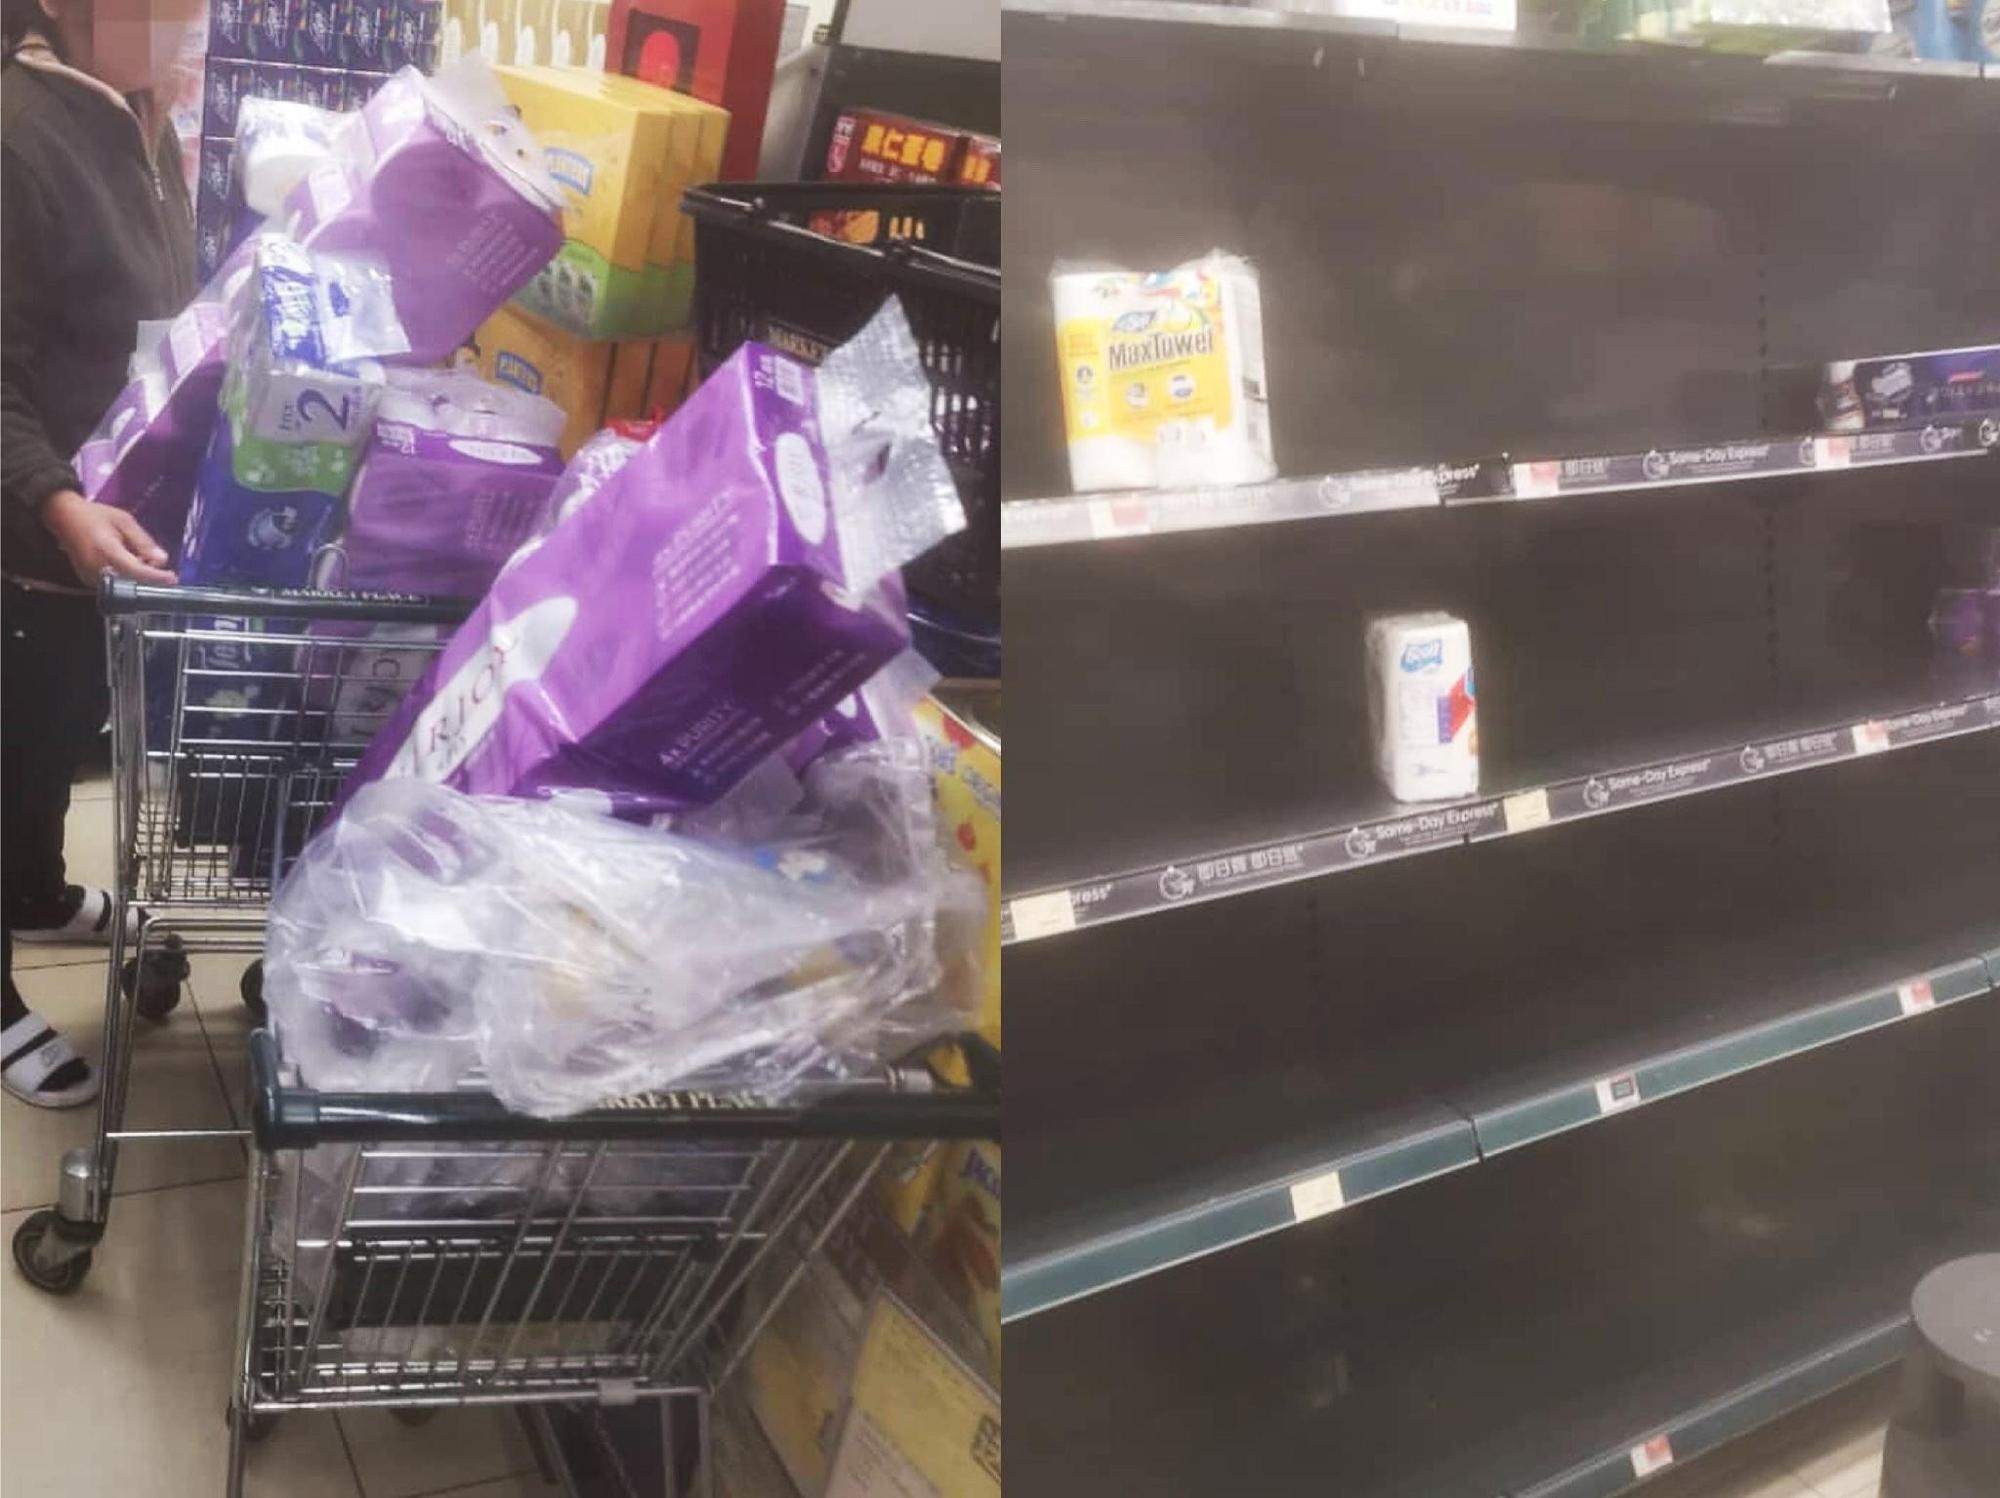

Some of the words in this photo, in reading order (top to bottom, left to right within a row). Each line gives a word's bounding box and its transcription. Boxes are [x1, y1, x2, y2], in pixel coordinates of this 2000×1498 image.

[297, 389, 350, 431] 2
[1608, 768, 1667, 791] Same-Day
[1668, 761, 1708, 779] Express
[1376, 814, 1446, 840] Same-Day
[1447, 804, 1495, 825] Express
